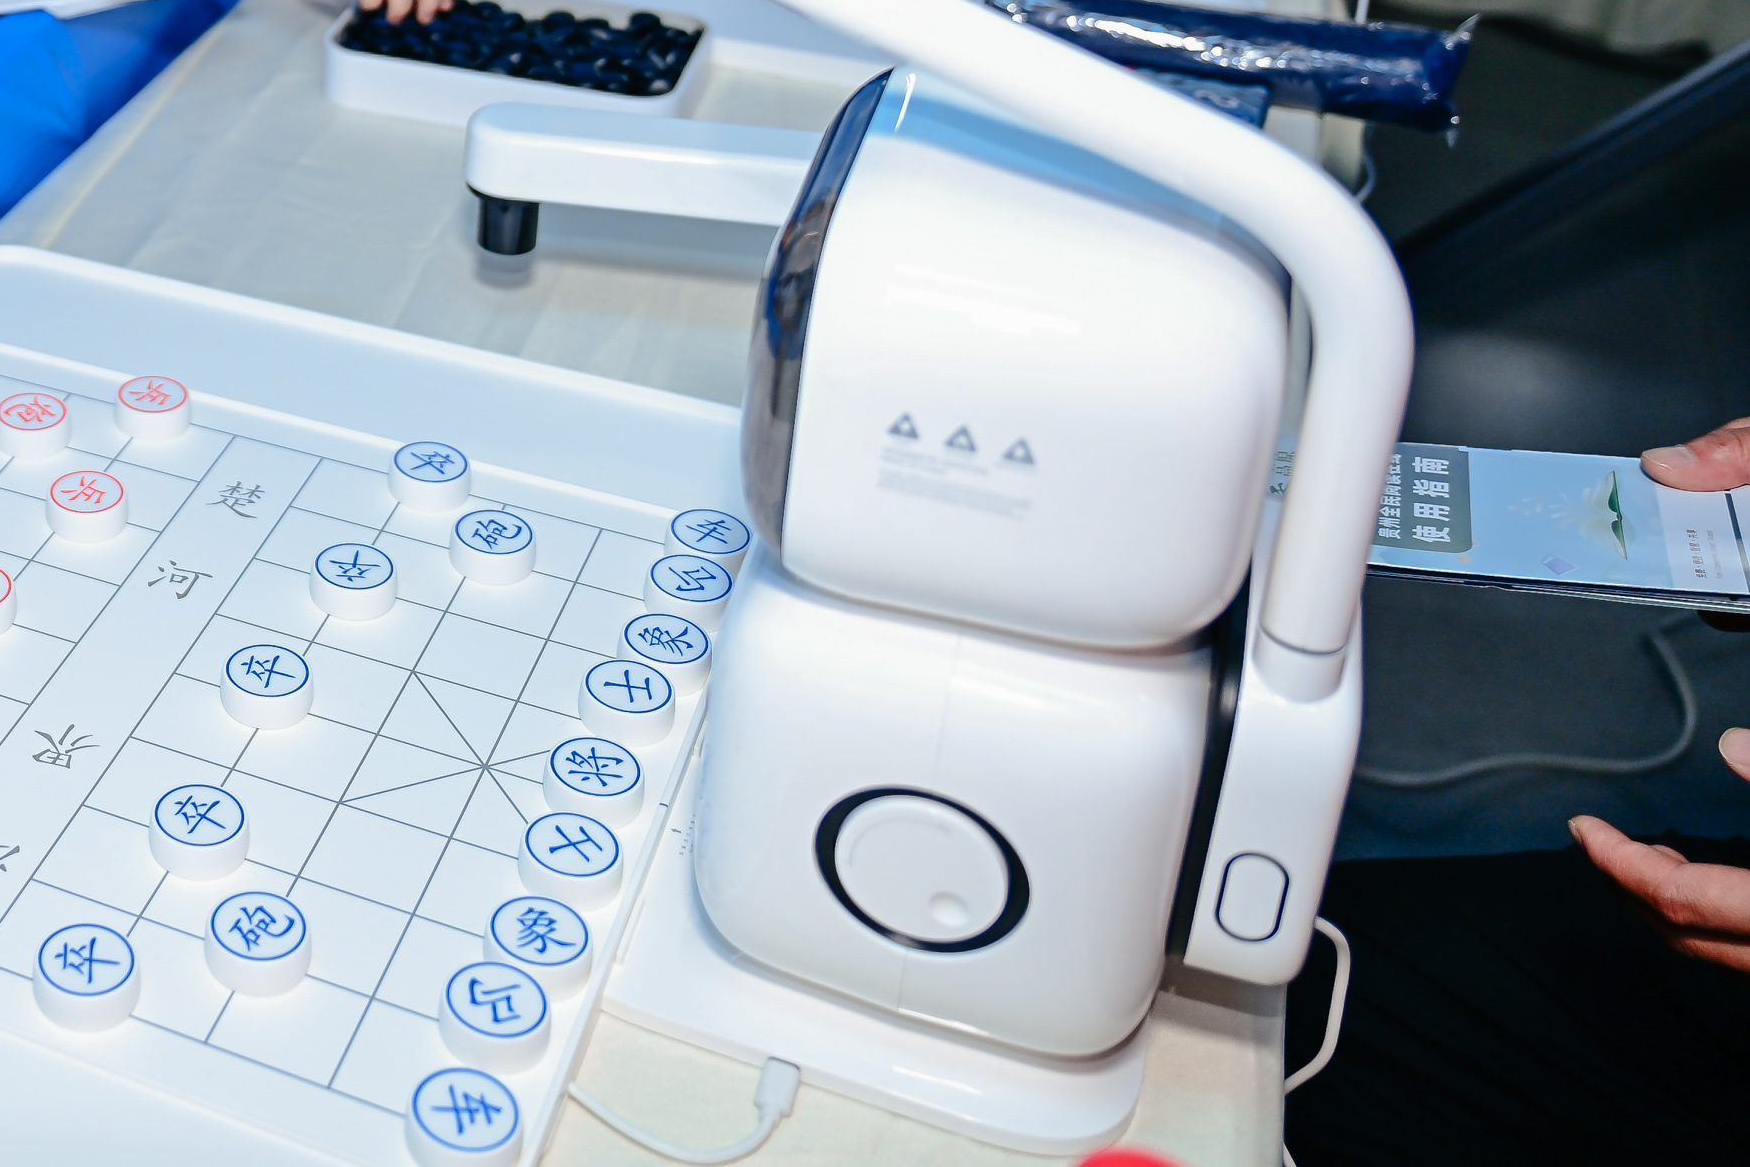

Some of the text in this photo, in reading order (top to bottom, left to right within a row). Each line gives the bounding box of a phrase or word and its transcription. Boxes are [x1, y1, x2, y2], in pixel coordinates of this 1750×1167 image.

[4, 396, 57, 423] 炮
[130, 381, 170, 405] 兵
[410, 451, 456, 476] 卒
[61, 477, 106, 504] 兵
[206, 480, 268, 519] 楚
[1411, 456, 1451, 543] 使用指南
[472, 519, 523, 549] 砲
[686, 518, 736, 551] 车
[147, 558, 214, 601] 河
[329, 550, 378, 584] 卒
[673, 562, 713, 596] 马
[638, 625, 692, 656] 象
[242, 655, 293, 688] 卒
[603, 670, 652, 703] 士
[33, 723, 101, 770] 界
[565, 747, 624, 787] 将
[175, 795, 226, 834] 卒
[549, 825, 603, 862] 士
[229, 906, 295, 951] 砲
[517, 907, 576, 954] 象
[55, 937, 119, 984] 卒
[468, 977, 520, 1024] 马
[432, 1085, 502, 1135] 车
